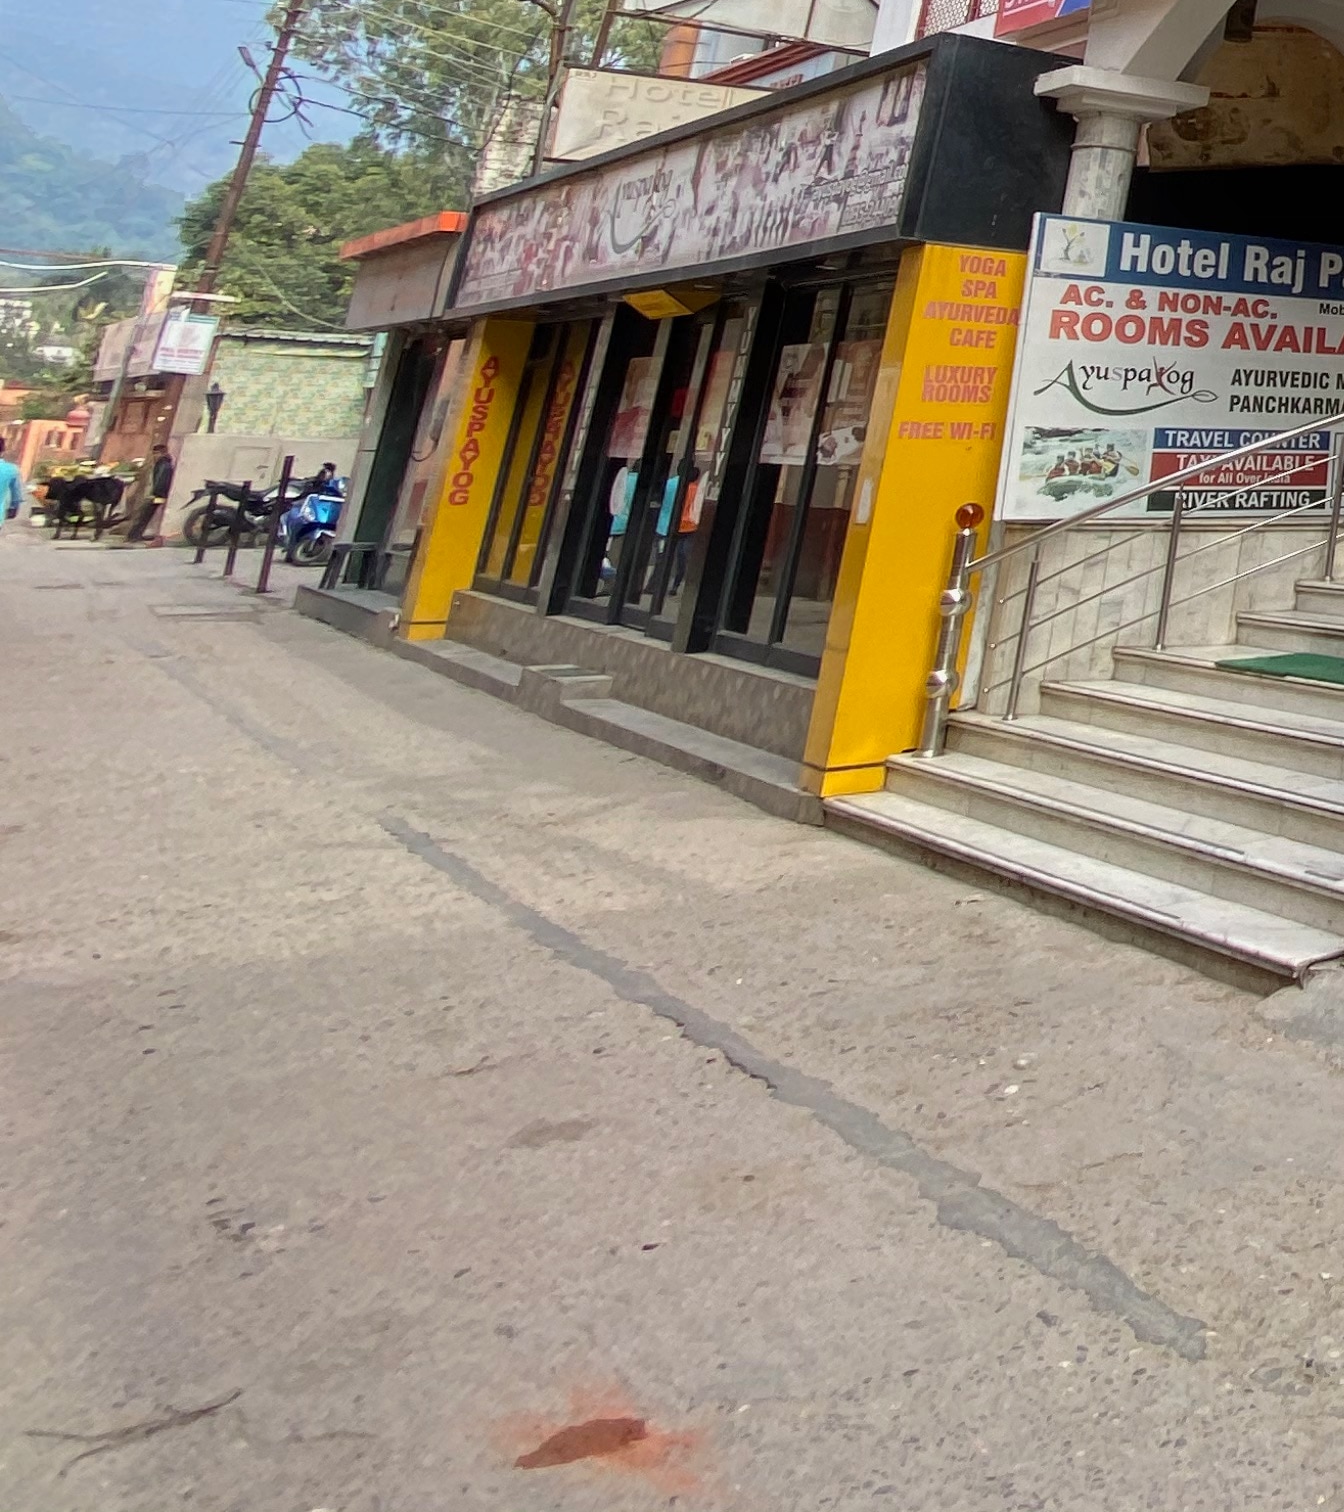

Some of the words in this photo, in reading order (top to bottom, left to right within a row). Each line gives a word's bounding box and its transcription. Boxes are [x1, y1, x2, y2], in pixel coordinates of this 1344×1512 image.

[959, 254, 1006, 277] YOGA
[1119, 231, 1230, 280] Hotel
[1242, 245, 1305, 294] Raj
[960, 279, 997, 299] SPA
[1059, 283, 1113, 309] AC.
[1124, 288, 1148, 310] &
[1158, 291, 1278, 320] NON-AC.
[923, 301, 1021, 328] AYURVEDA
[949, 328, 997, 349] CAFE
[1048, 309, 1211, 348] ROOMS
[923, 365, 998, 386] LUXURY
[1231, 369, 1330, 389] AYURVEDIC
[921, 384, 993, 403] ROOMS
[448, 355, 500, 506] AYUSPAYOG
[898, 421, 945, 440] FREE
[949, 422, 997, 441] WI-FI
[1165, 430, 1234, 448] TRAVEL
[1217, 472, 1233, 484] All
[1236, 473, 1261, 484] Over
[1235, 491, 1311, 508] RAFTING
